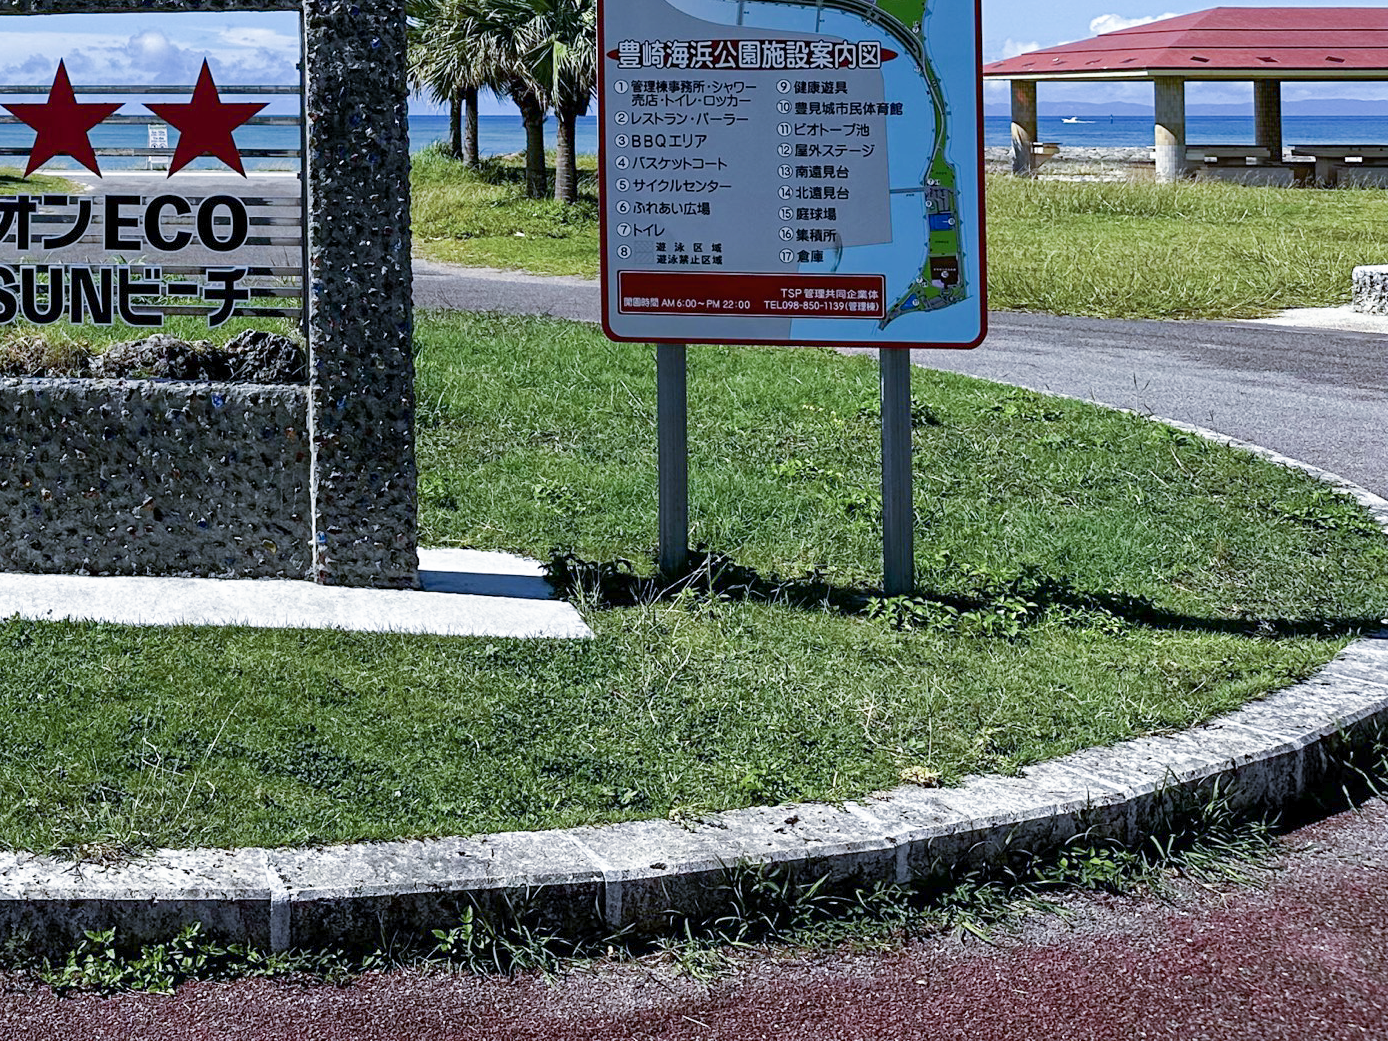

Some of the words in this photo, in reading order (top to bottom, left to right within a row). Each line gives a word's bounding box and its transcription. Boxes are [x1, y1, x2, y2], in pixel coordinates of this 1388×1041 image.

[618, 40, 881, 69] 豊崎海浜公園施設案内図
[794, 81, 848, 94] 健康遊具
[795, 102, 903, 115] 豊見城市民体育館
[795, 144, 875, 157] 屋外ステージ
[632, 157, 727, 170] バスケットコート
[795, 165, 849, 179] 南遠見台
[633, 179, 732, 193] サイクルセンター
[796, 186, 850, 200] 北遠見台
[633, 202, 711, 215] ふれあい広場
[796, 208, 837, 221] 庭球場
[633, 223, 665, 237] トイレ
[796, 228, 837, 242] 集積所
[797, 250, 824, 263] 倉庫
